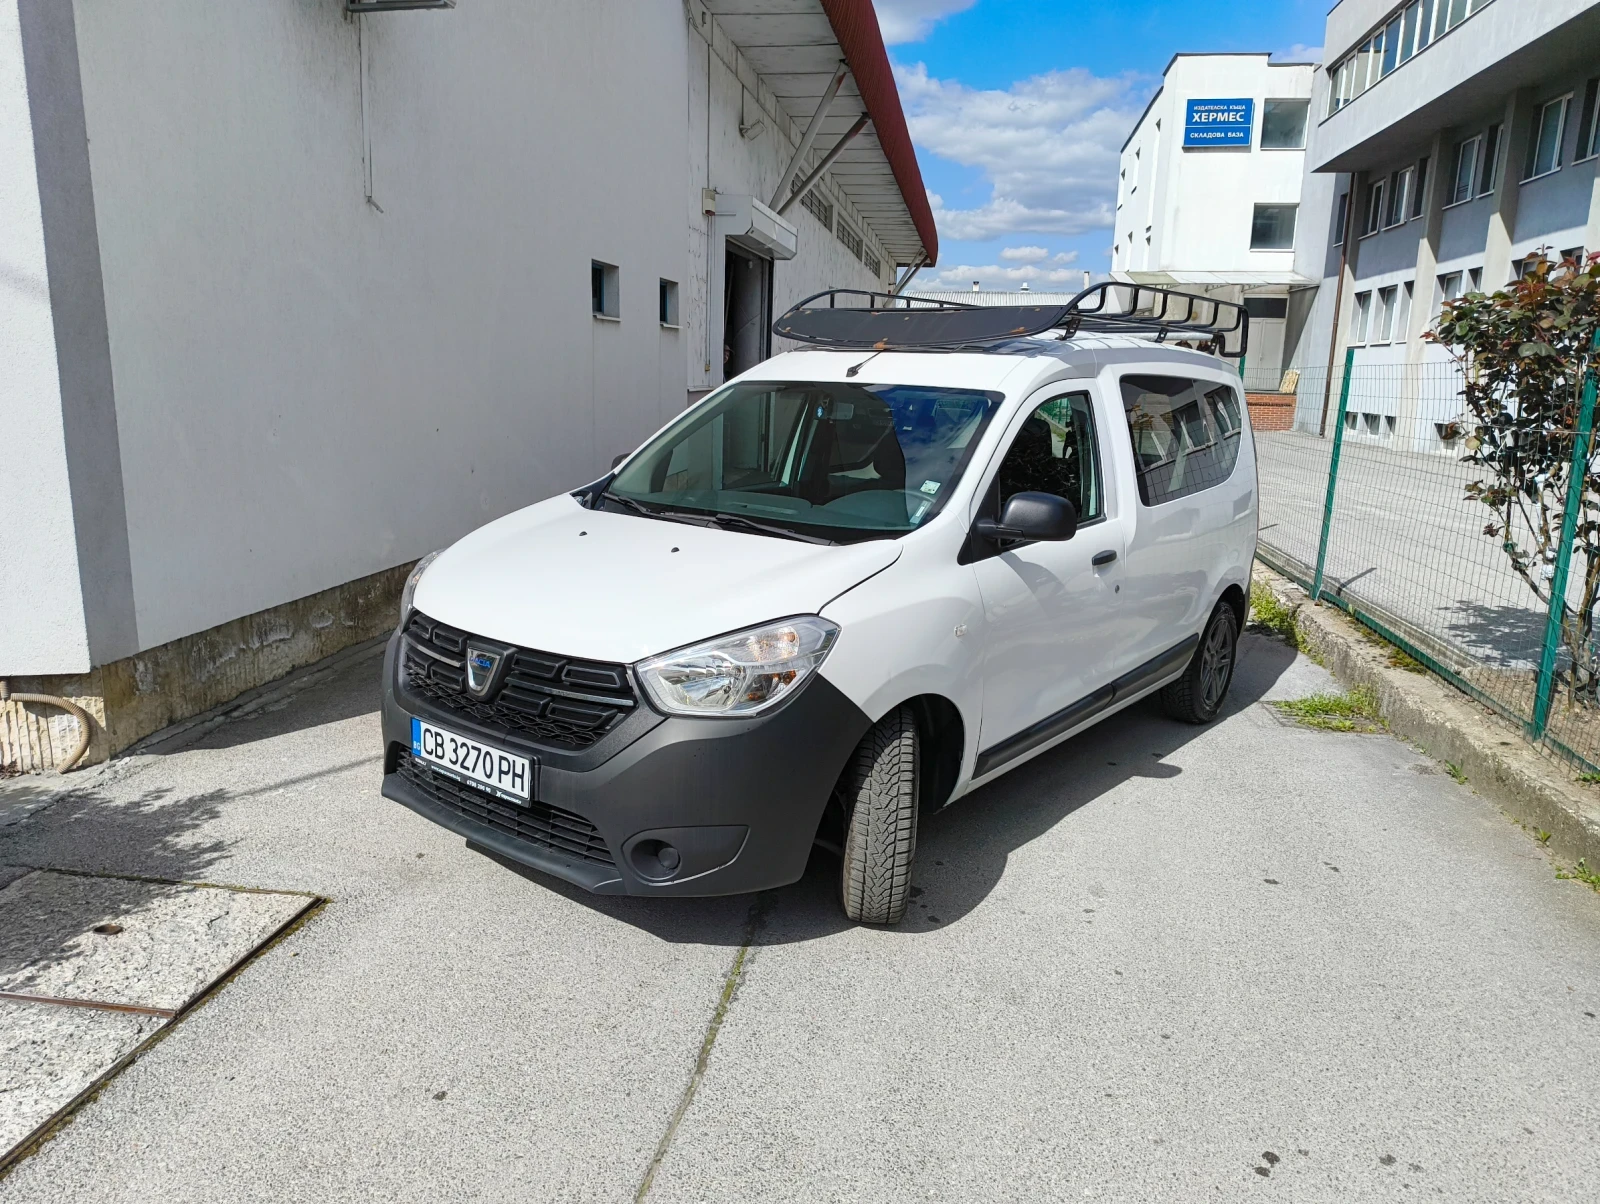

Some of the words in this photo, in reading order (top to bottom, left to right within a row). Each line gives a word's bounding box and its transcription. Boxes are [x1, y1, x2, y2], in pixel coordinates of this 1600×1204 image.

[1192, 112, 1244, 122] ХЕРМЕС
[412, 740, 421, 750] BG
[423, 728, 445, 760] CB
[448, 738, 494, 780] 3270
[498, 755, 526, 792] PH
